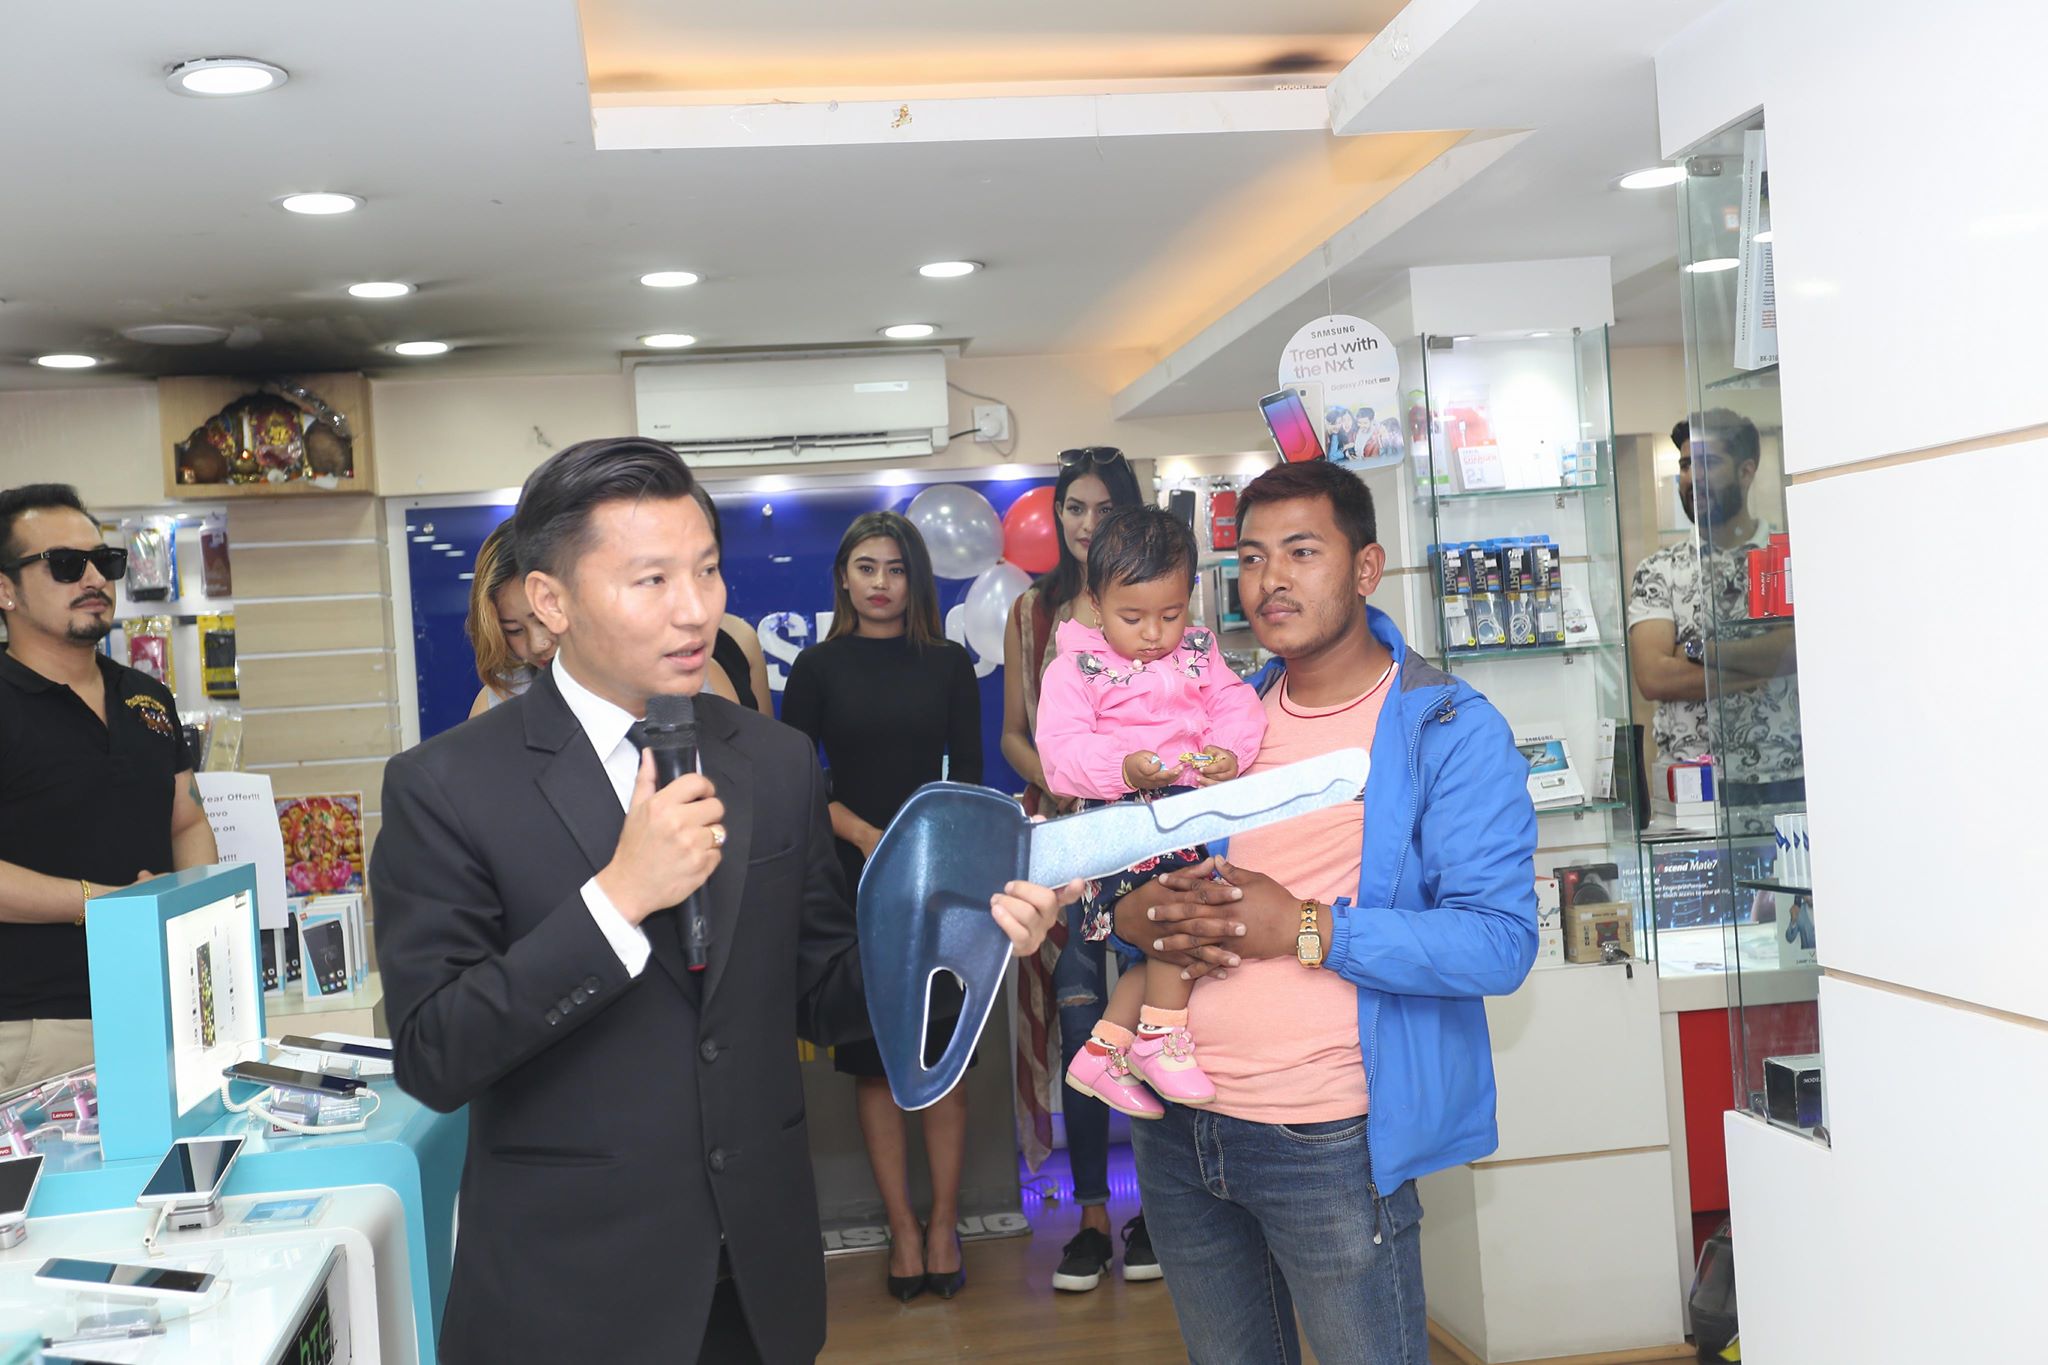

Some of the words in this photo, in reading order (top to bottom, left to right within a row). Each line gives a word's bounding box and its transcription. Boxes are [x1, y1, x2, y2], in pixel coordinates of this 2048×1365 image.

[1311, 325, 1356, 339] SAMSUNG
[1288, 342, 1338, 362] Trend
[1341, 337, 1379, 354] with
[1294, 362, 1321, 379] the
[1325, 357, 1355, 375] Nxt
[1657, 861, 1689, 873] Ascend
[1690, 858, 1719, 871] Mate7
[52, 1111, 74, 1119] Lenovo
